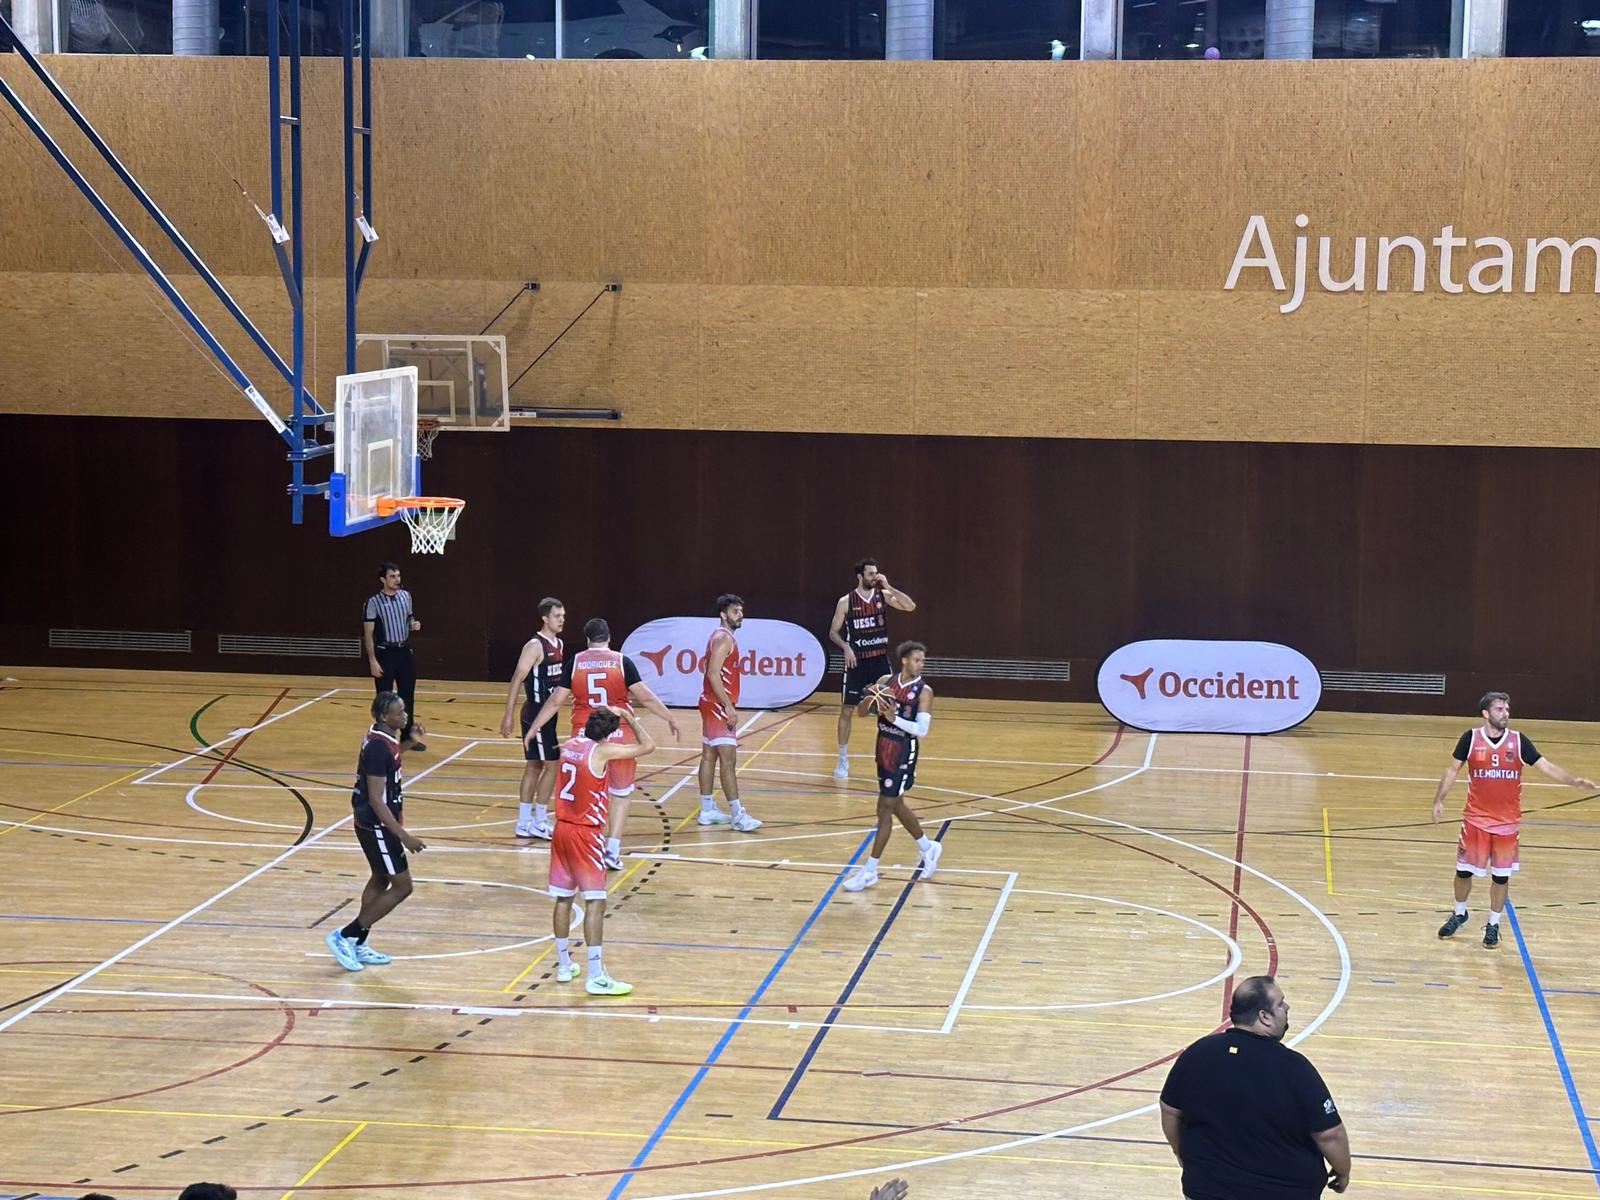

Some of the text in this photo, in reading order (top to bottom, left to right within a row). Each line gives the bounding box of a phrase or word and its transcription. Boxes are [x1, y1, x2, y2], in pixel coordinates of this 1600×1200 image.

[1223, 213, 1600, 314] Ajuntam
[852, 616, 876, 630] UESC
[675, 648, 806, 677] Ocdent
[587, 672, 608, 708] 5
[1158, 671, 1300, 701] Occident
[1491, 753, 1500, 767] 9
[559, 762, 577, 801] 2
